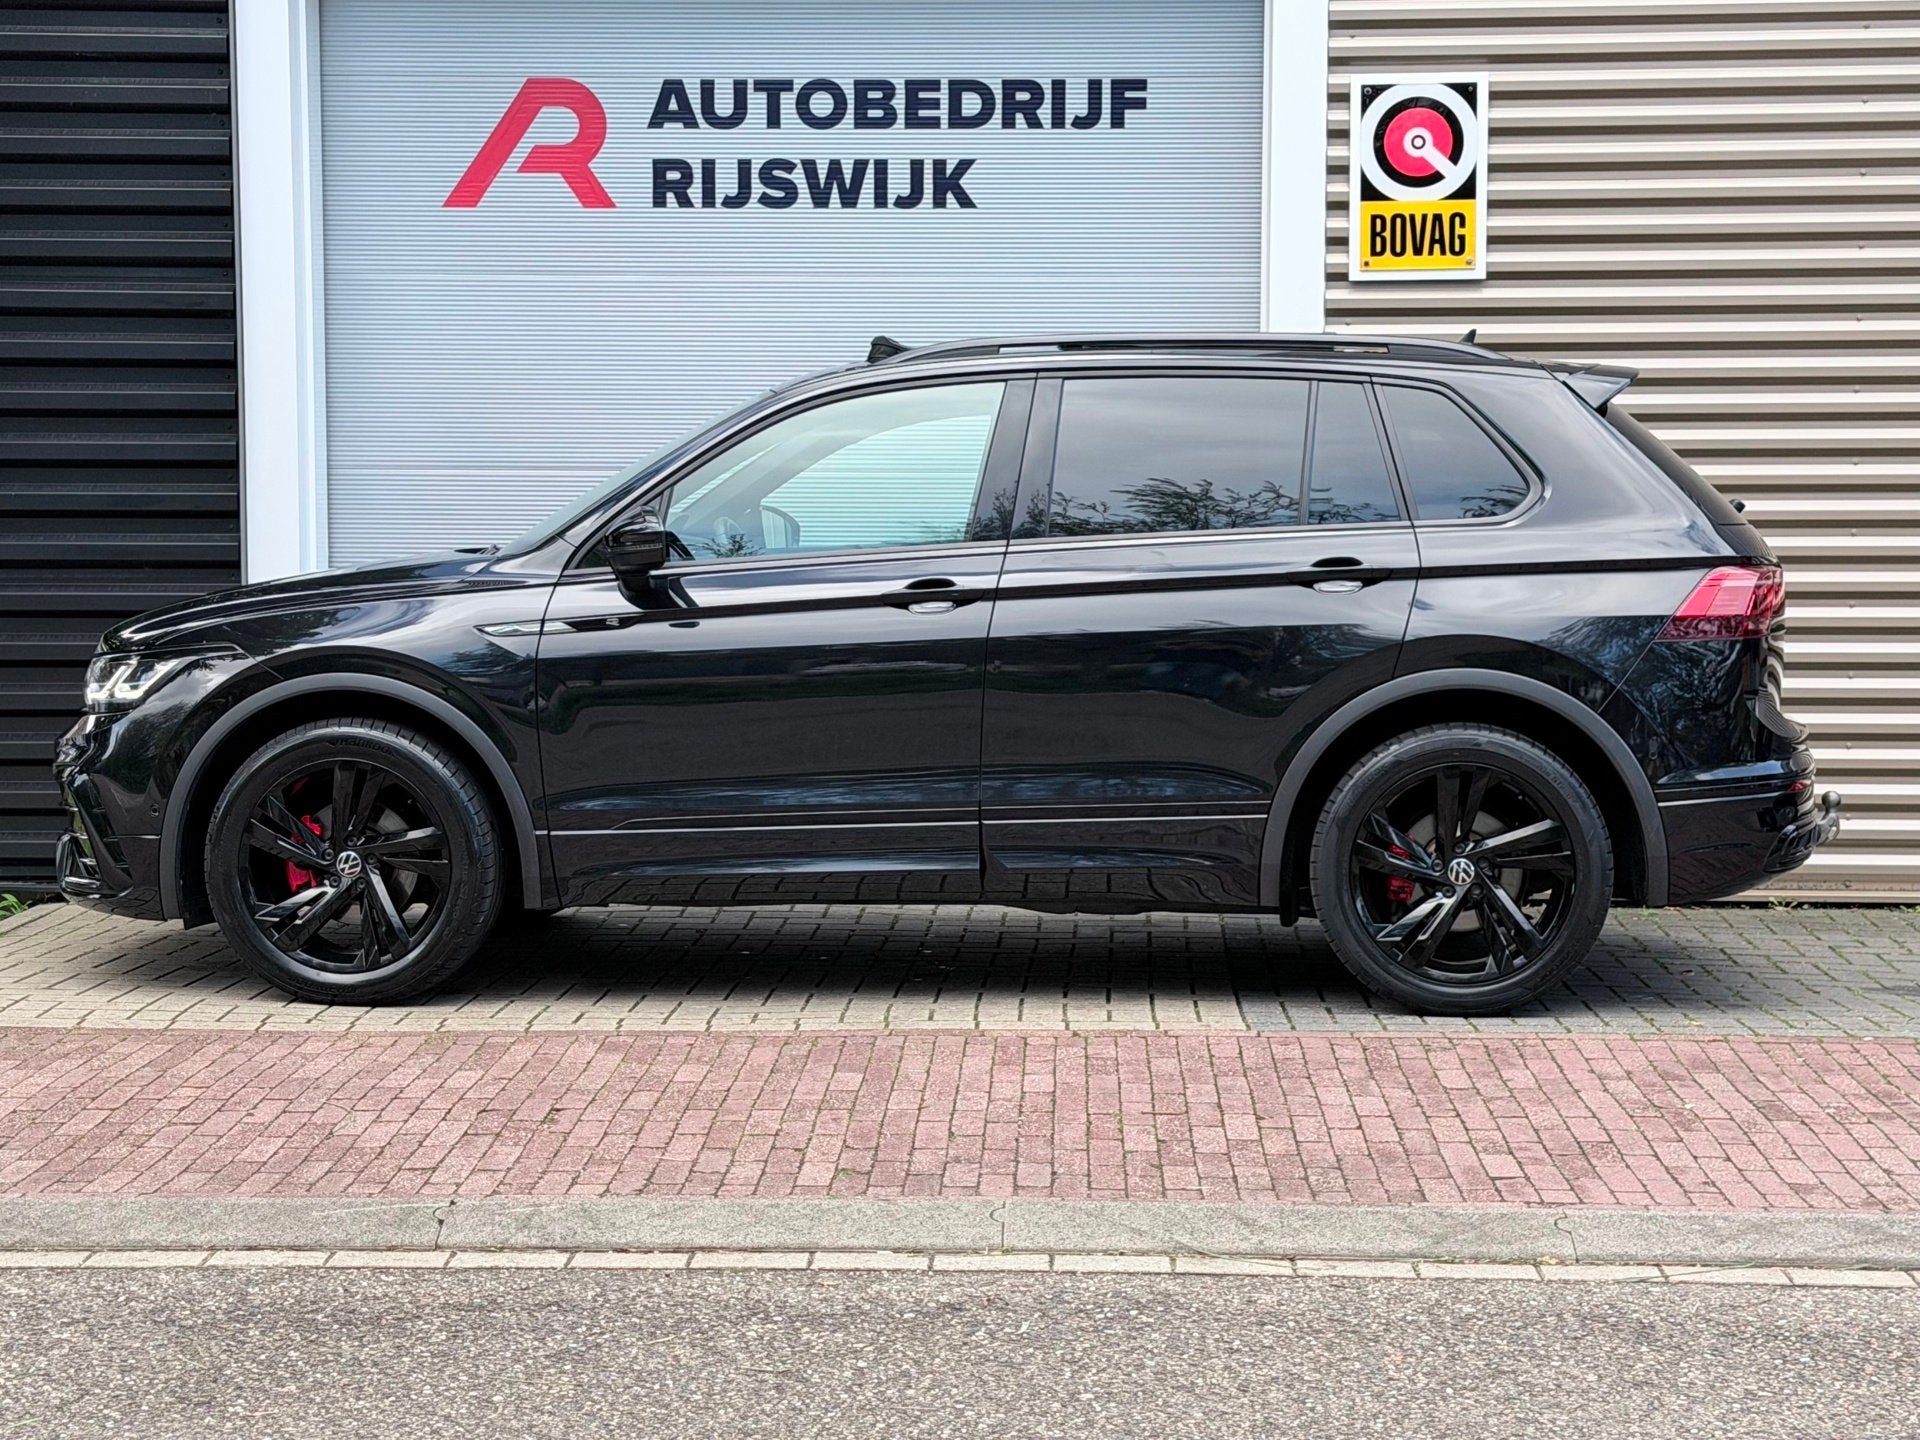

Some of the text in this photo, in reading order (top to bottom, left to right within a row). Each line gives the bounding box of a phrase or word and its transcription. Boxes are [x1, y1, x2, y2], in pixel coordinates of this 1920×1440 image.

[647, 78, 1148, 130] AUTOBEDRIJF
[651, 158, 978, 209] RIJSWIJK
[1369, 212, 1466, 258] BOVAG
